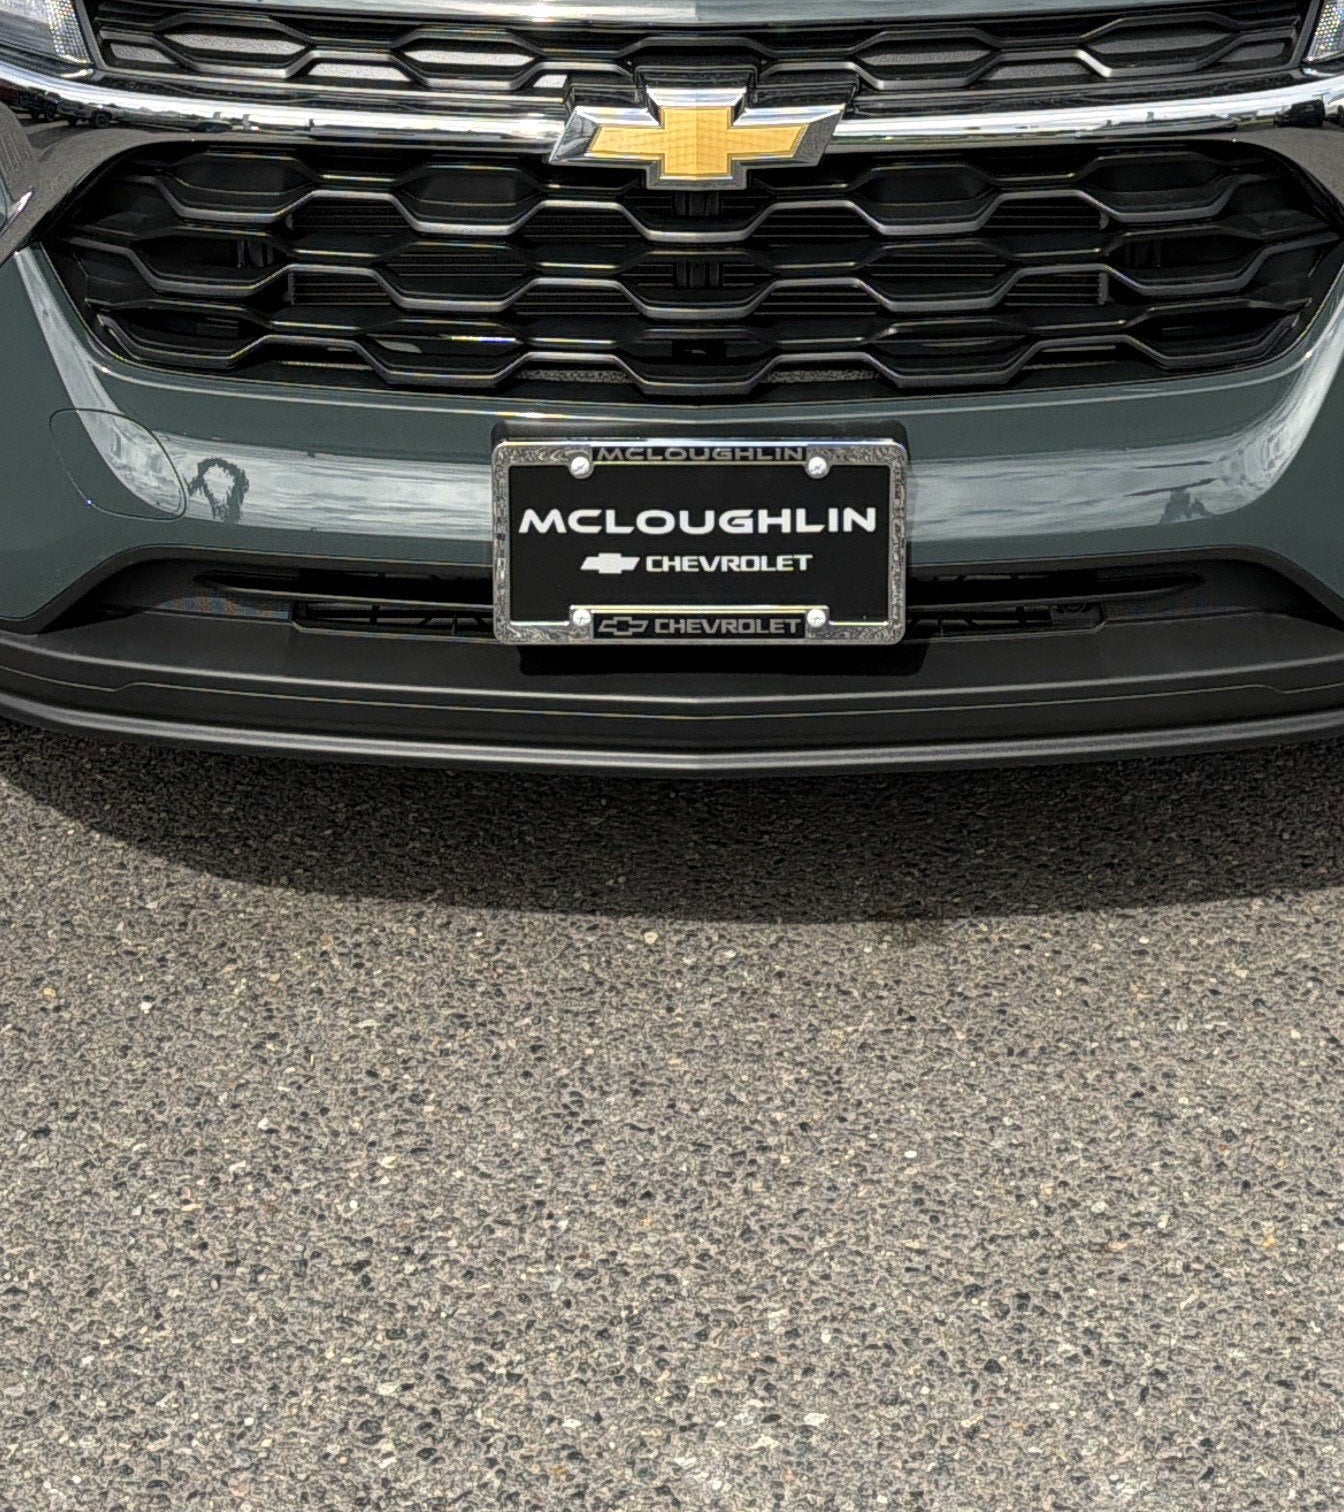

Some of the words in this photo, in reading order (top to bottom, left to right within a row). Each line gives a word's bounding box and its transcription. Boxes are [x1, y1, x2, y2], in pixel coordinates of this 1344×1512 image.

[596, 446, 804, 462] MCLOUGHLIN
[518, 507, 877, 535] MCLOUGHLIN
[645, 554, 813, 573] CHEVROLET
[654, 617, 802, 635] CHEVROLET
